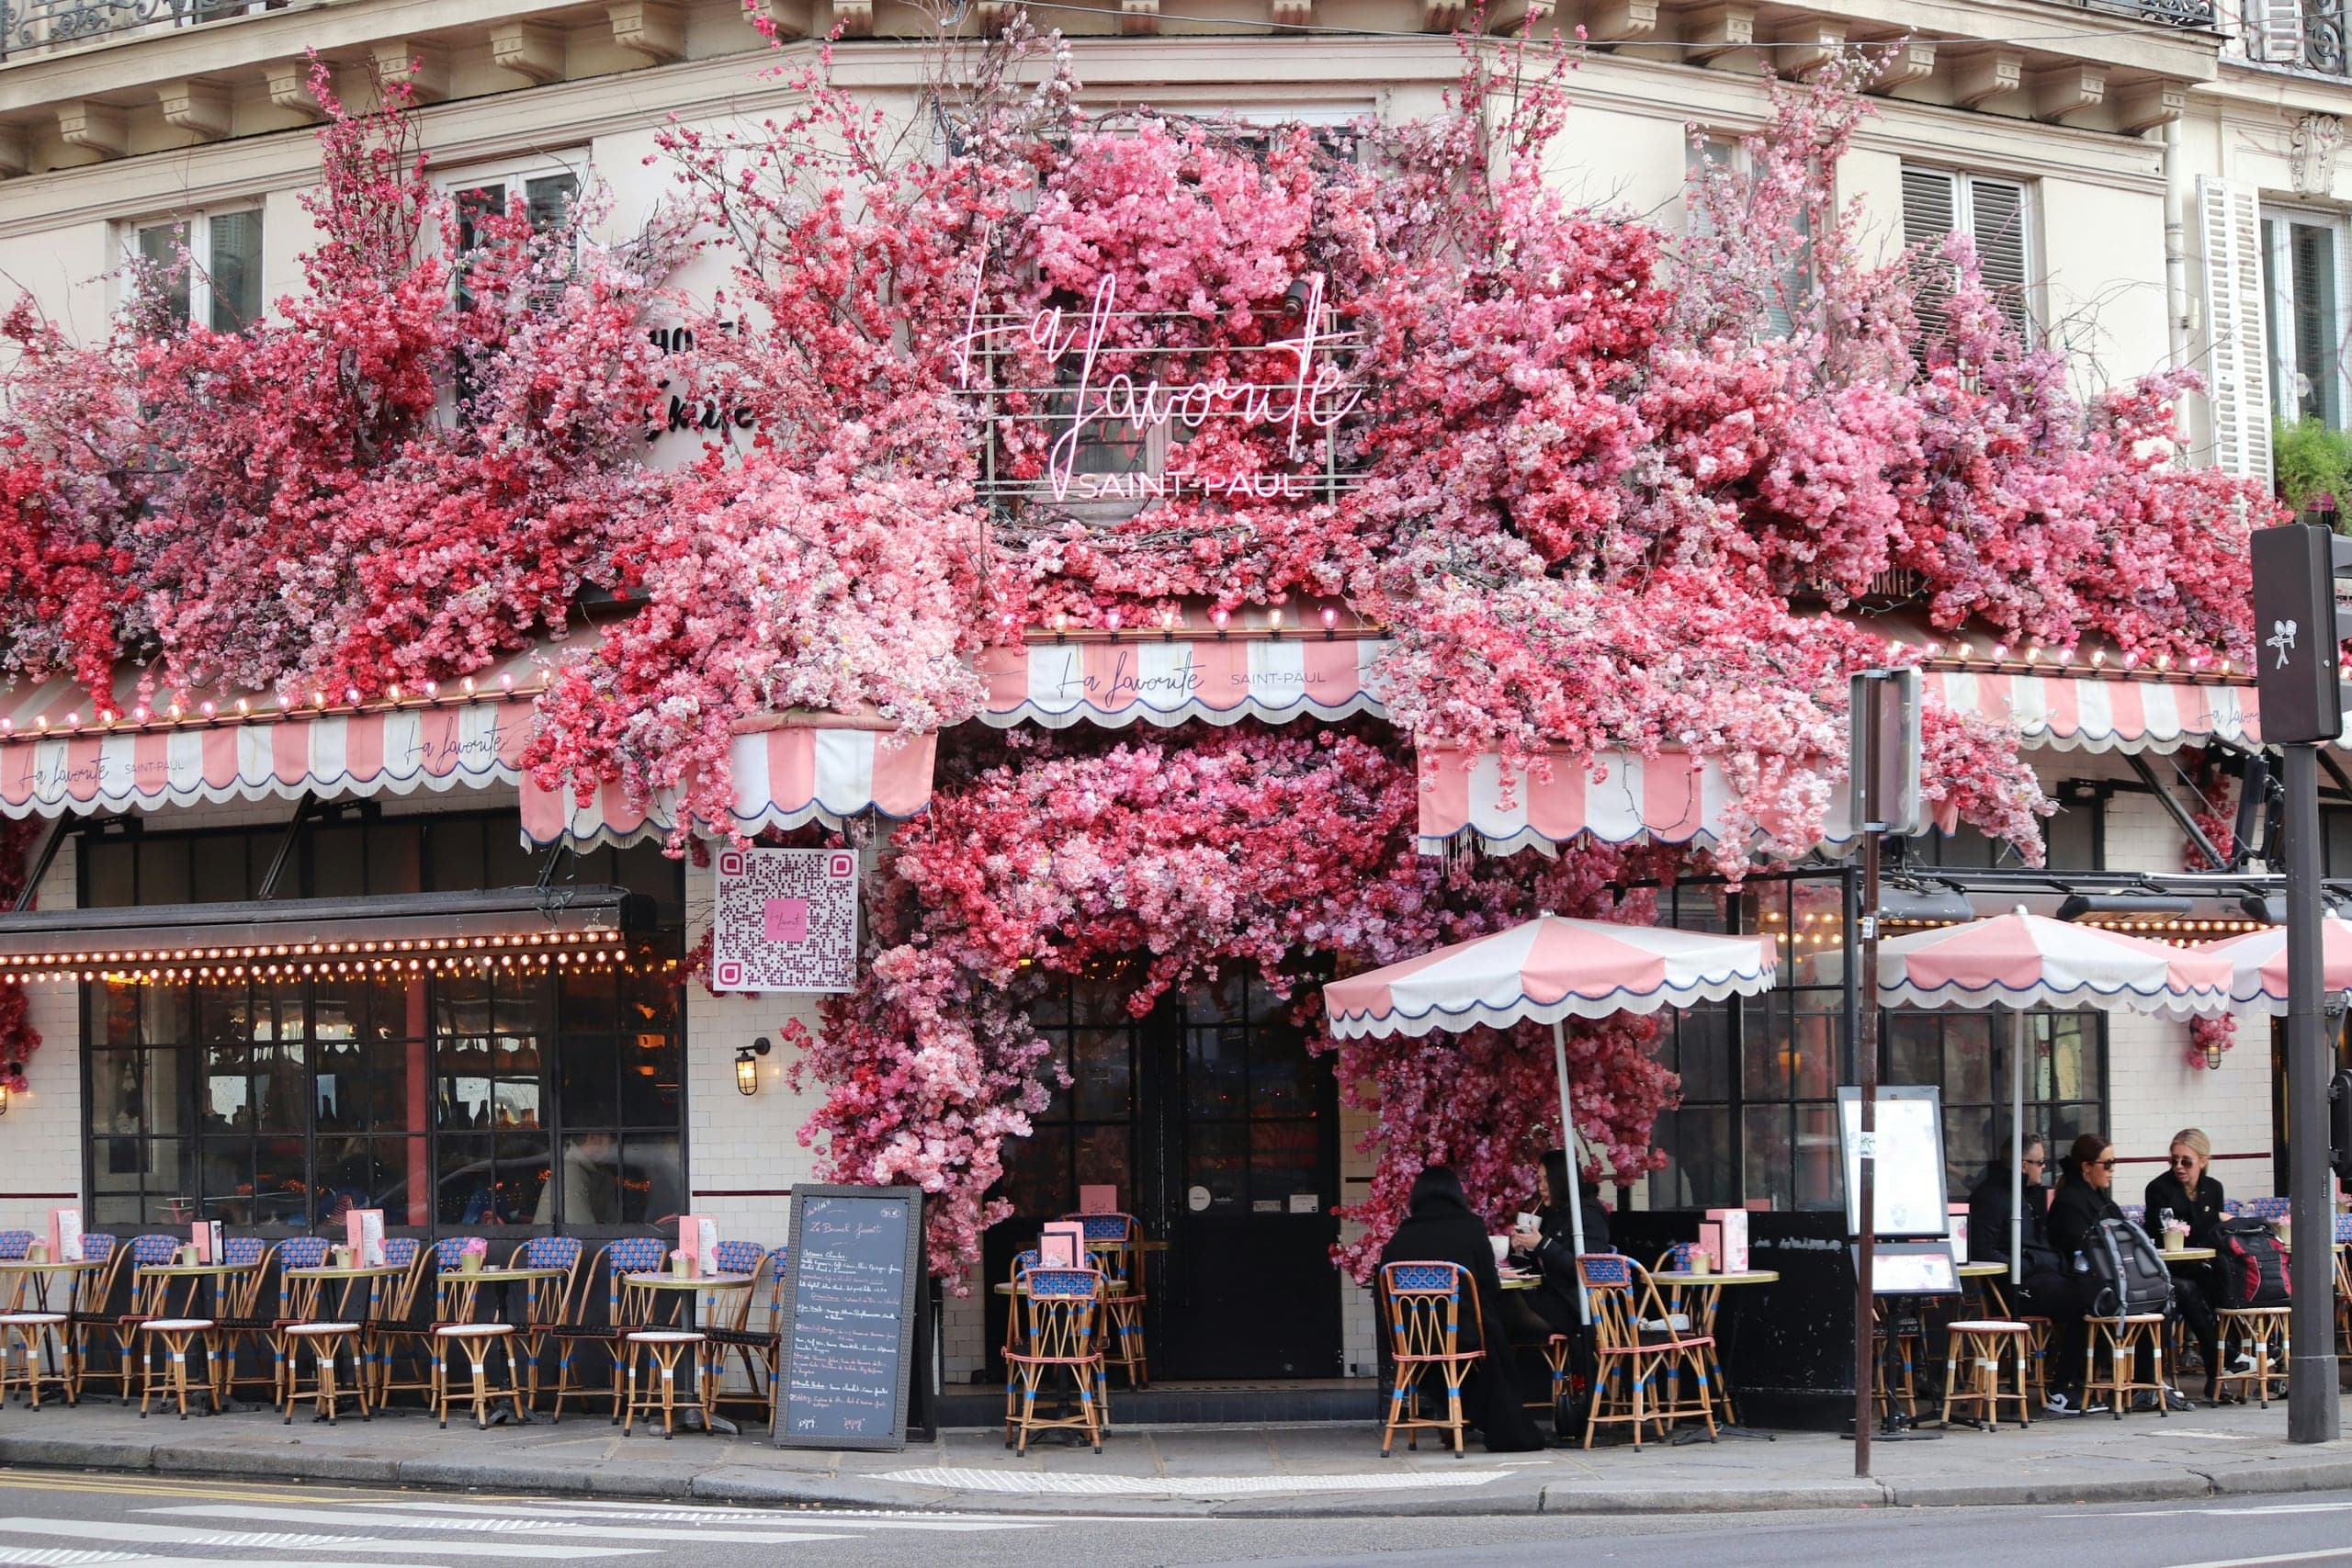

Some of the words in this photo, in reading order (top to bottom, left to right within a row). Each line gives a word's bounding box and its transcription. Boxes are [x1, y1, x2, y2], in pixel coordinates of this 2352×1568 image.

[951, 220, 1077, 389] La
[1050, 274, 1366, 502] favorite
[1078, 470, 1304, 499] SAINT-PAUL
[1057, 651, 1100, 699] La
[1105, 650, 1205, 708] favorite
[1231, 671, 1326, 685] SAINT-PAUL
[2198, 689, 2222, 728] La
[2226, 689, 2261, 737] favor
[404, 720, 434, 764] La
[435, 714, 509, 772] favorite
[19, 750, 46, 792] La
[48, 744, 110, 799] favorite
[125, 758, 184, 774] SAINT-PAUL
